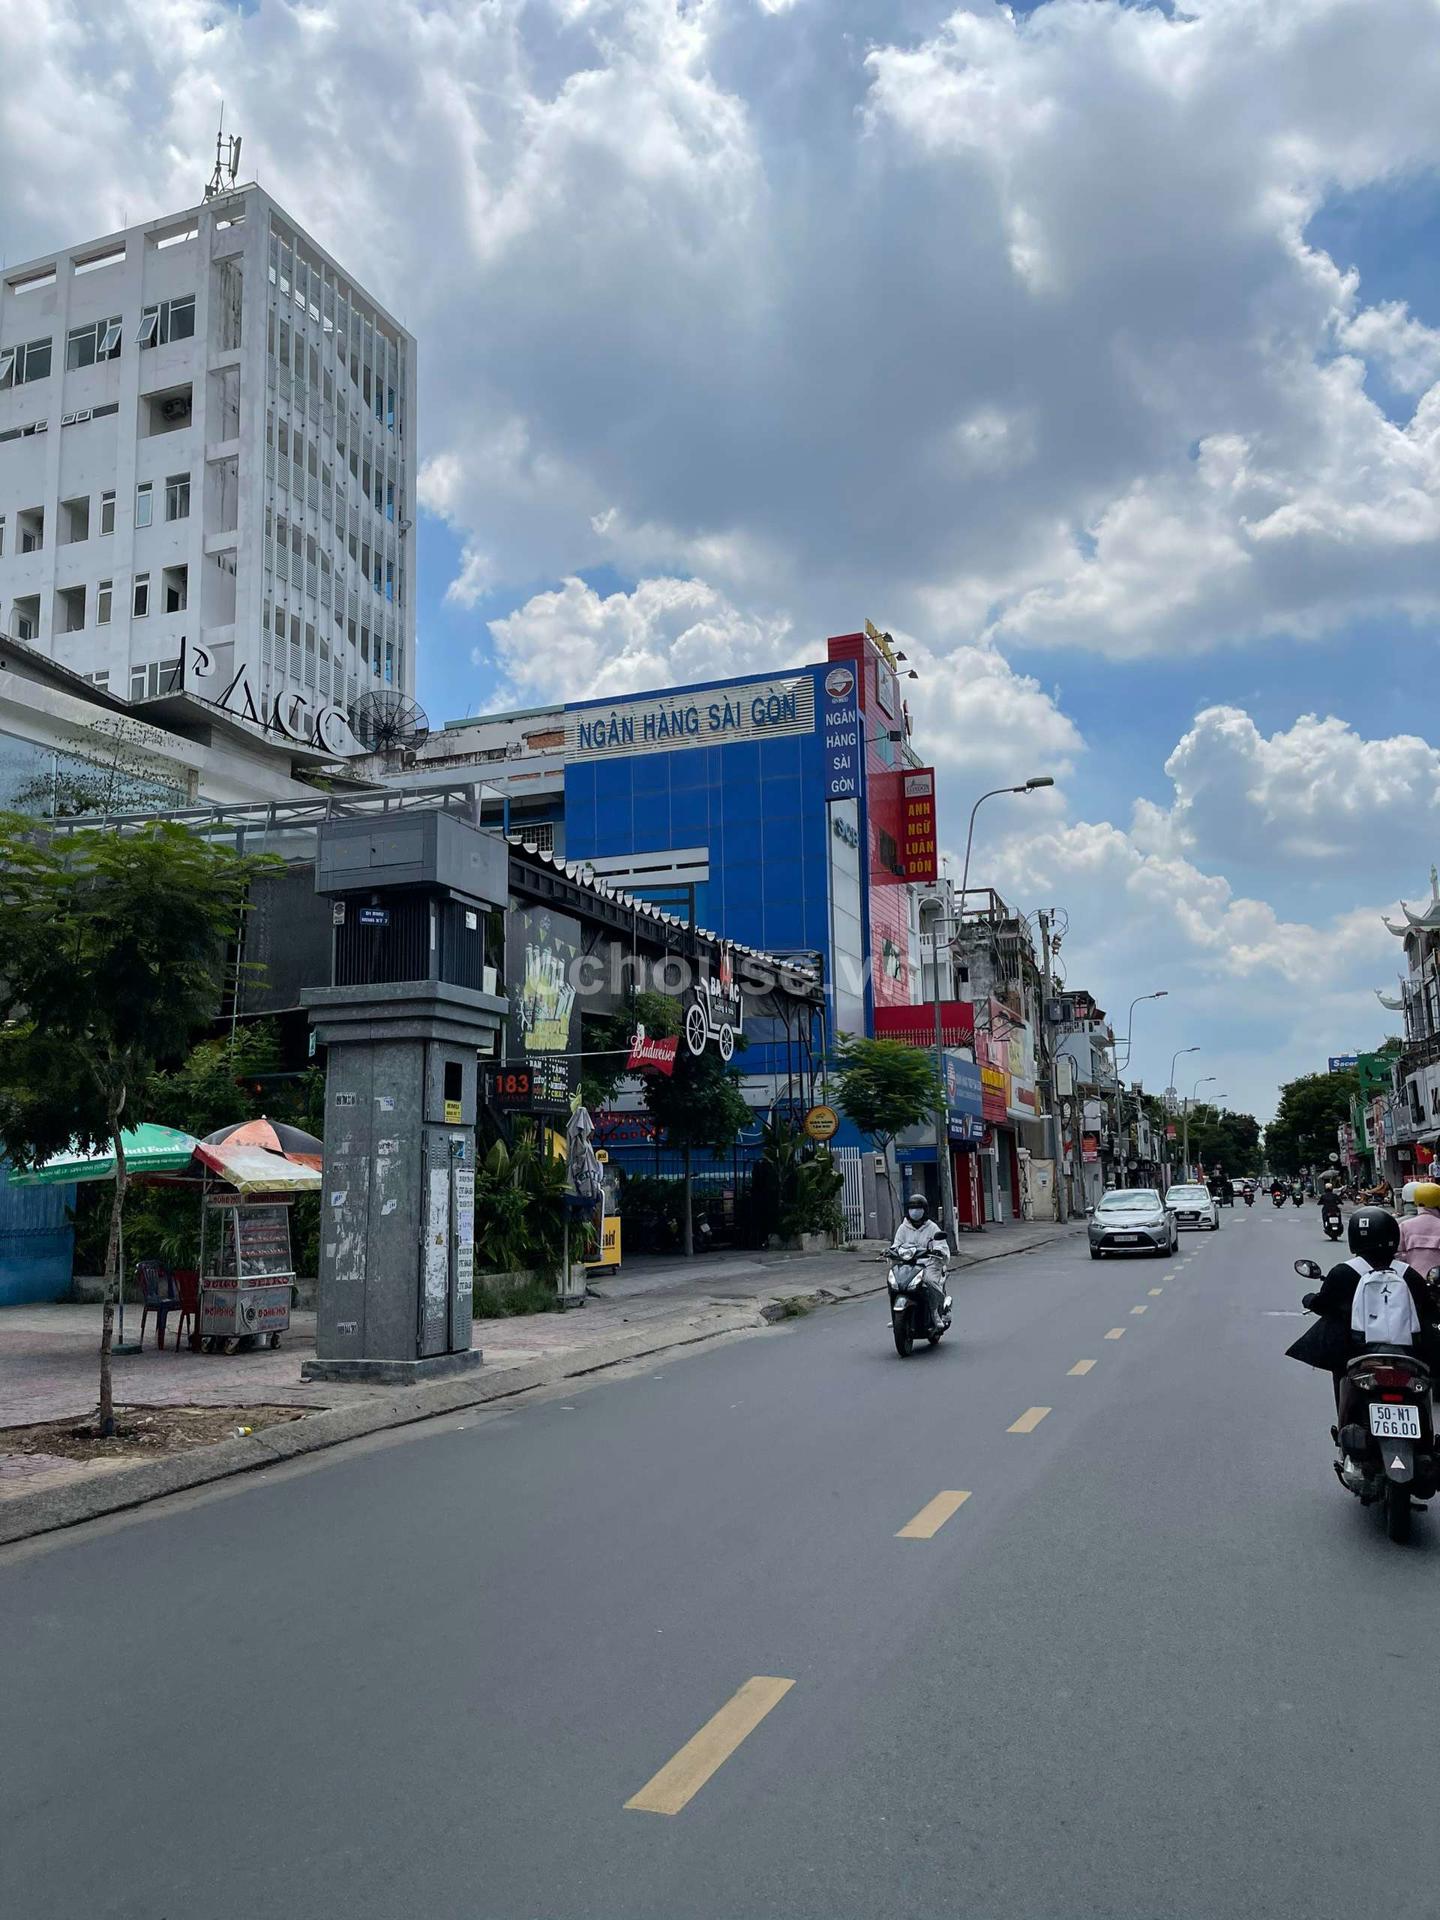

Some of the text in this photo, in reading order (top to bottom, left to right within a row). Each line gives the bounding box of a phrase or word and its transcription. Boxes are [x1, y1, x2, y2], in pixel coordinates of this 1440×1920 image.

[579, 688, 797, 750] NGÂN HÀNG SÀI GÒN
[825, 709, 856, 727] NGÂN
[826, 733, 857, 749] HÀNG
[833, 756, 851, 770] SÀI
[831, 777, 855, 793] GÒN
[908, 802, 931, 817] ANH
[905, 839, 934, 855] LUÂN
[631, 1034, 676, 1062] Budweiser
[496, 1074, 529, 1094] 183
[1377, 1407, 1410, 1421] 50-N1
[1374, 1421, 1417, 1436] 766.00
